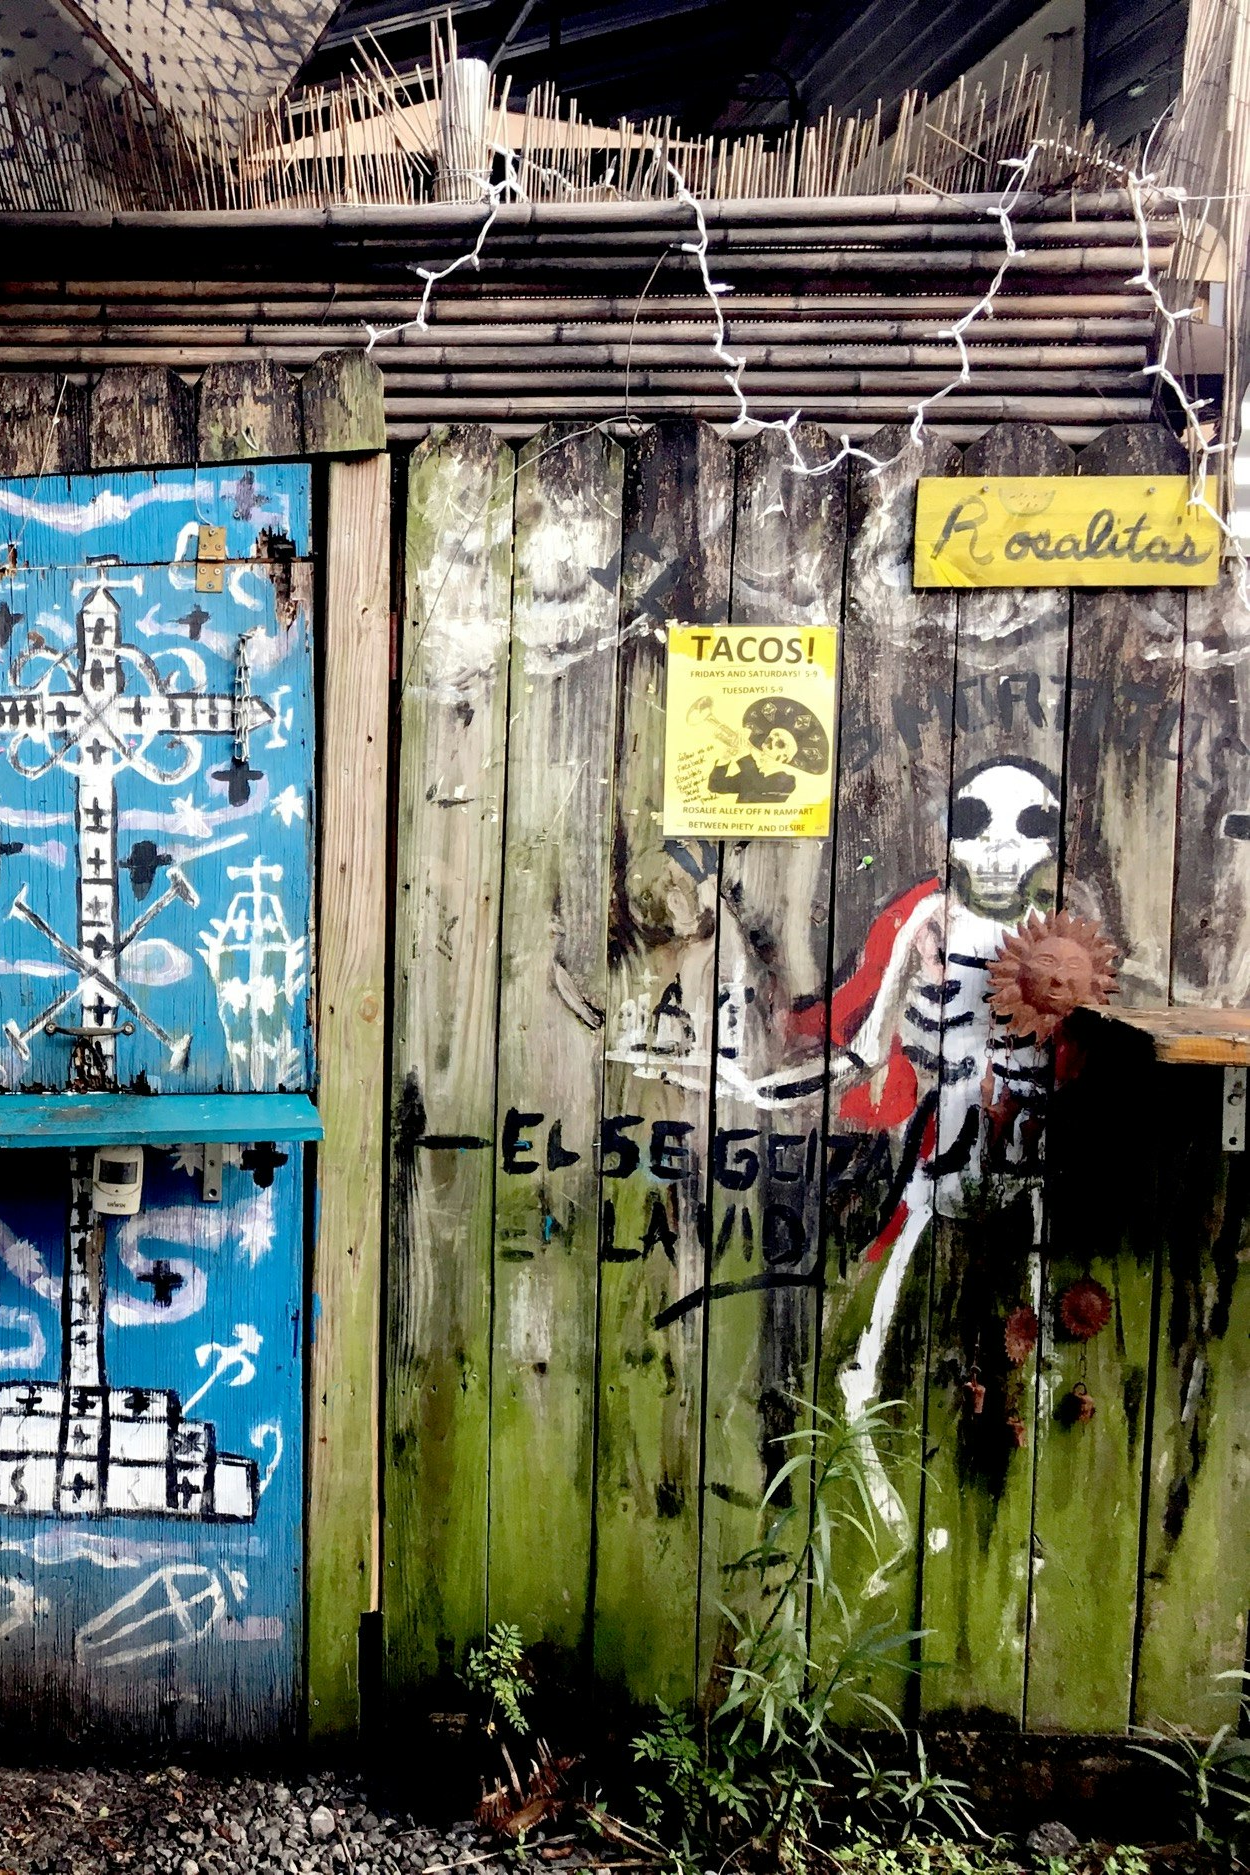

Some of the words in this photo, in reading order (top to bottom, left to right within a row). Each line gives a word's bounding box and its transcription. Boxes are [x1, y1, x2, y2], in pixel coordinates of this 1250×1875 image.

[690, 635, 815, 664] TACOS!
[690, 670, 725, 678] FRIDAYS
[727, 670, 746, 678] AND
[748, 670, 800, 678] SATURDAYS!
[805, 670, 818, 678] 5-9
[771, 686, 783, 694] 5-9
[683, 806, 717, 814] ROSALIE
[719, 806, 743, 815] ALLEY
[688, 821, 728, 829] BETWEEN
